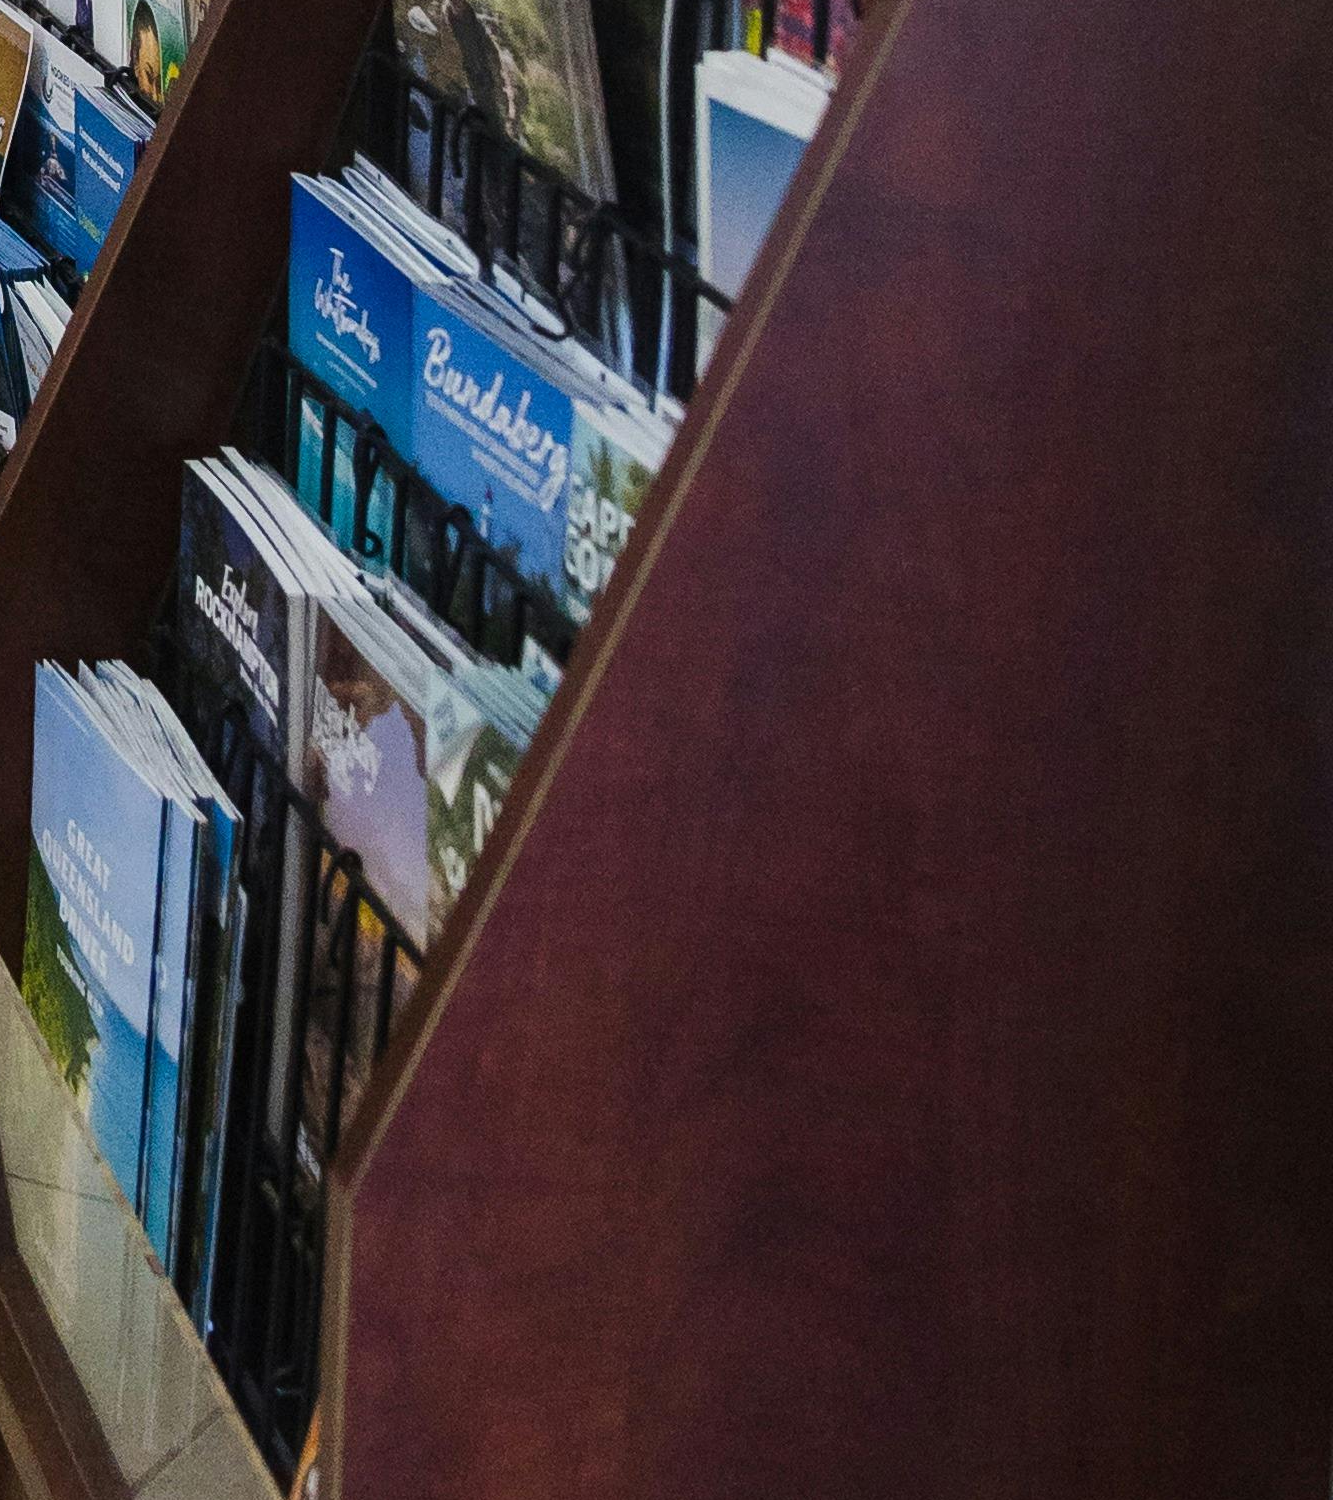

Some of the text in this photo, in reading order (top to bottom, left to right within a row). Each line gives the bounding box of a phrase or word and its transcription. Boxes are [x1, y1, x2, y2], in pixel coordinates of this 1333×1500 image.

[423, 327, 569, 513] Bundaberg
[42, 827, 135, 967] QUEENSLAND
[67, 818, 111, 892] GREAT
